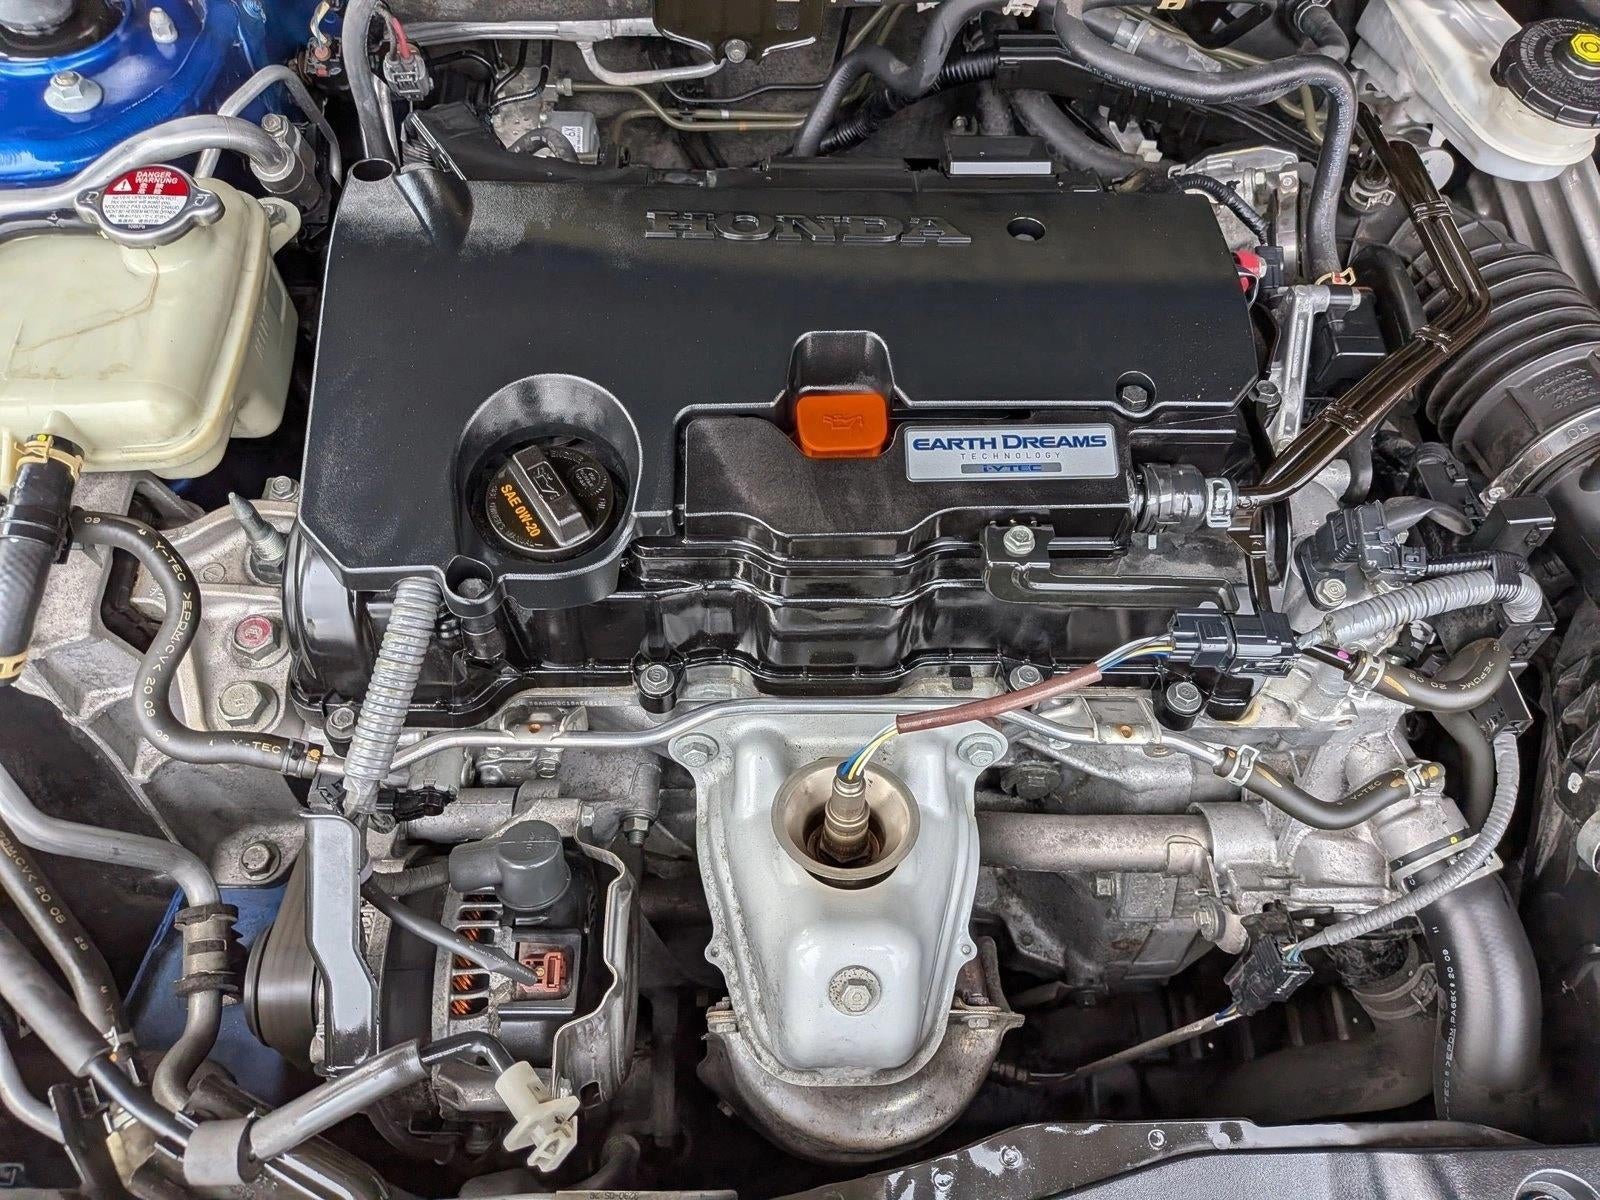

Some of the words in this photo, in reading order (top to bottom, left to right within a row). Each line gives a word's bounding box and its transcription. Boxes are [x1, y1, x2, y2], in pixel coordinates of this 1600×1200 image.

[645, 210, 971, 244] HONDA
[912, 437, 997, 450] EARTH
[1002, 434, 1107, 450] DREAMS
[961, 451, 1061, 460] TECHNOLOGY
[501, 484, 519, 508] SAE
[155, 541, 187, 582] Y-TEC
[143, 677, 156, 694] 20
[143, 701, 156, 717] 09
[231, 738, 282, 754] Y-TEC
[1350, 780, 1382, 800] Y-TEC
[35, 886, 51, 902] 20
